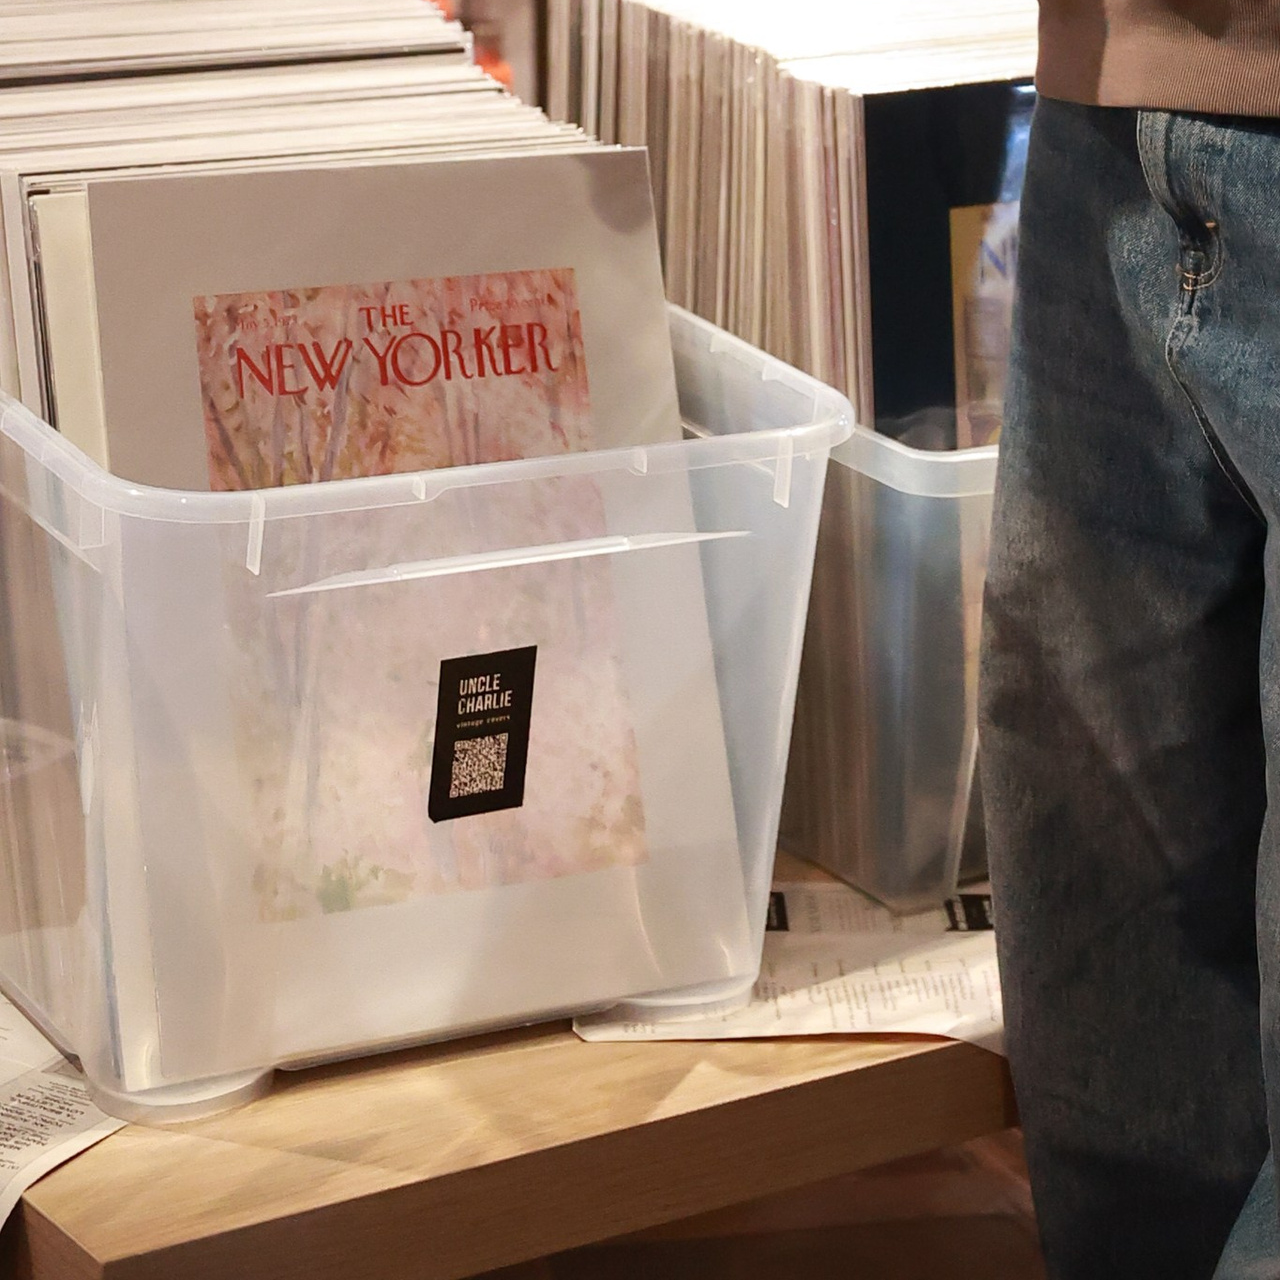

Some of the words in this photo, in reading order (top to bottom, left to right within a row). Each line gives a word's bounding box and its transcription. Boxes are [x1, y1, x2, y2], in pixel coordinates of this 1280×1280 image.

[359, 304, 414, 333] THE
[236, 336, 353, 399] NEW
[362, 322, 560, 387] YORKER
[459, 673, 501, 696] UNCLE
[457, 689, 513, 715] CHARLIE
